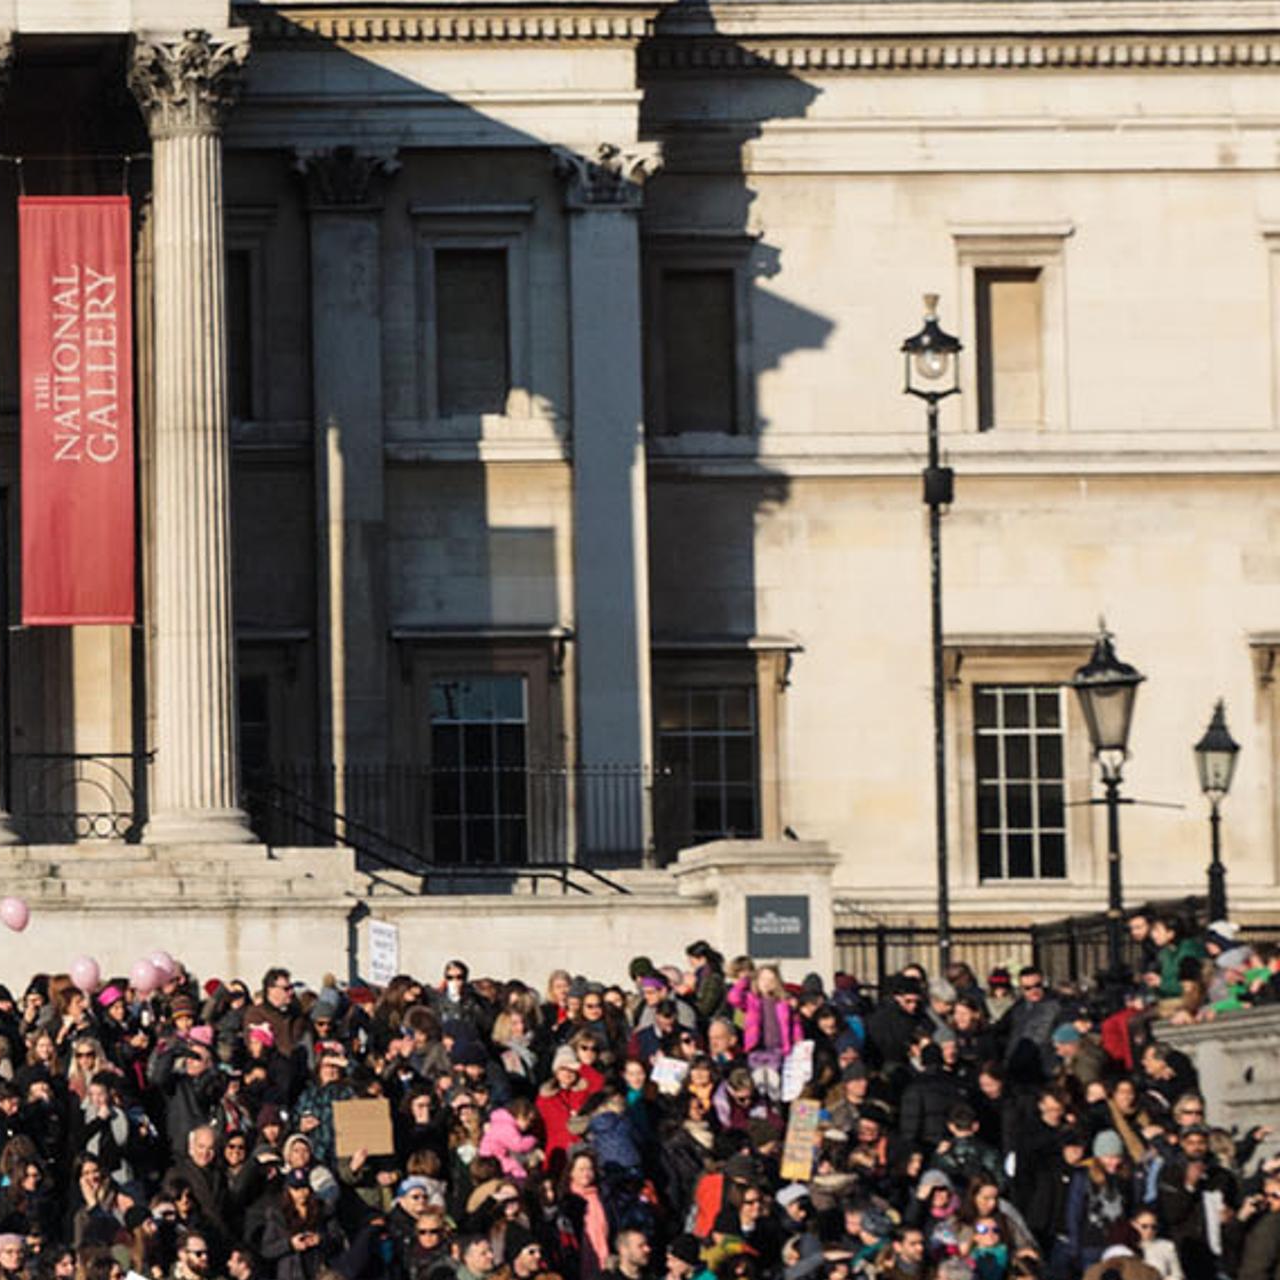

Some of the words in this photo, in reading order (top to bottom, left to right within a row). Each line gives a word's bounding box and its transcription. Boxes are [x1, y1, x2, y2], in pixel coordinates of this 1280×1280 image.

[35, 373, 50, 411] THE
[52, 264, 81, 462] NATIONAL
[85, 266, 119, 464] GALLERY
